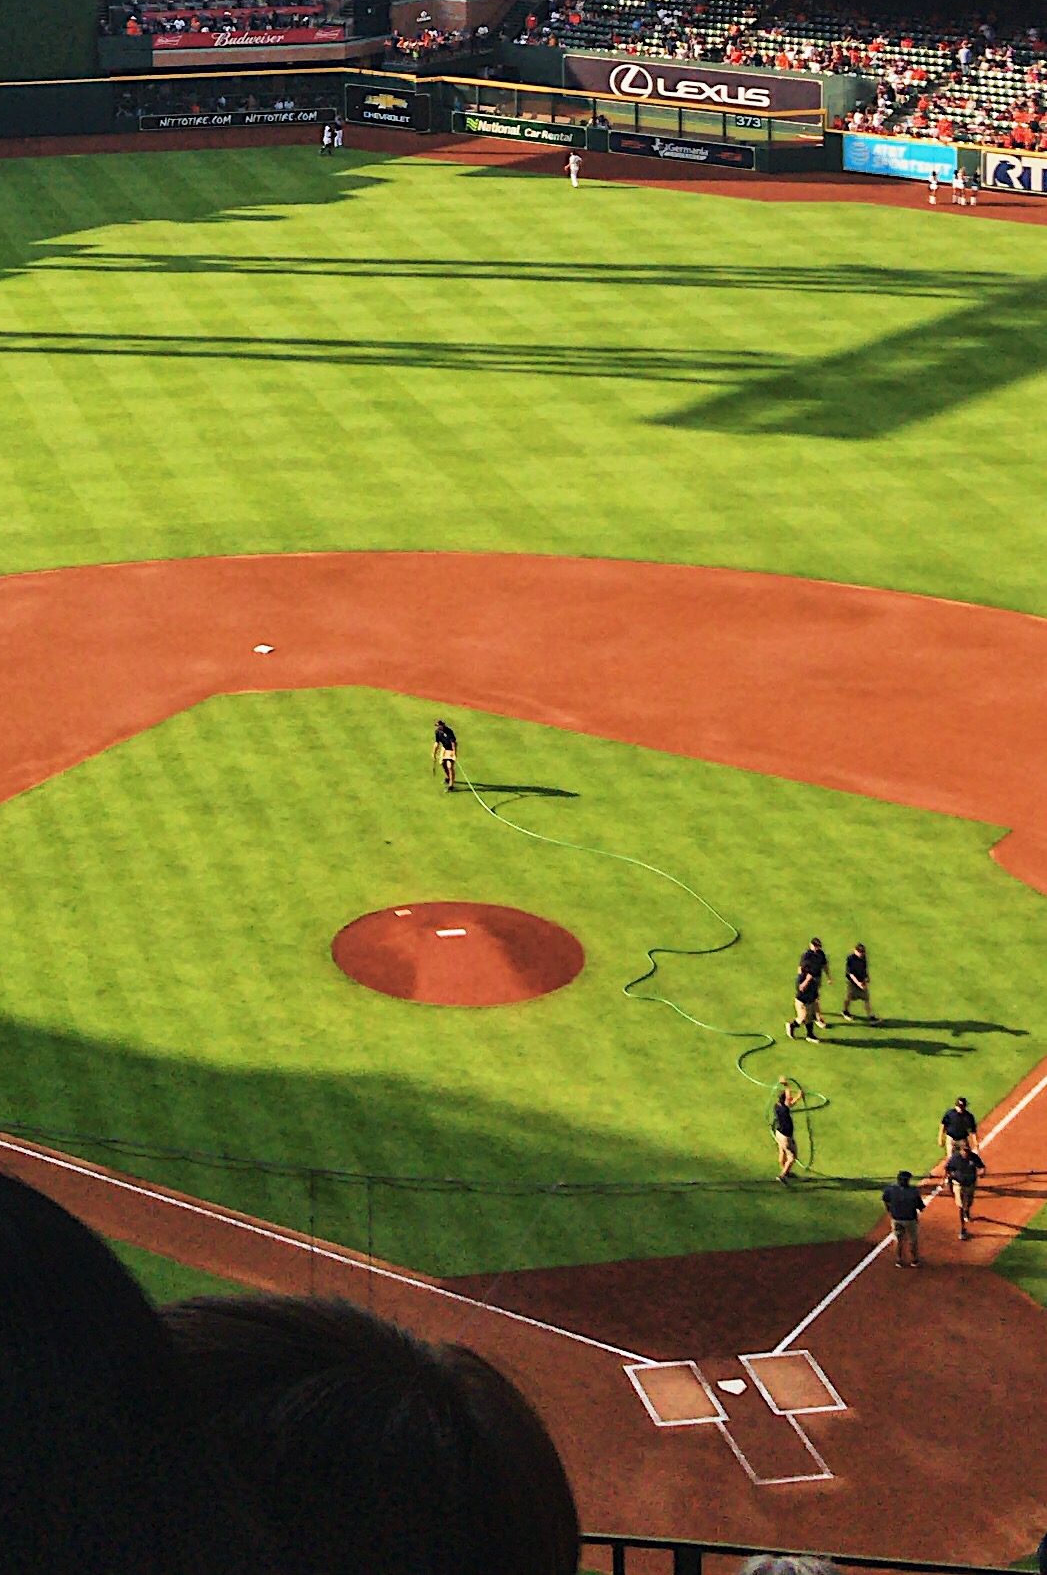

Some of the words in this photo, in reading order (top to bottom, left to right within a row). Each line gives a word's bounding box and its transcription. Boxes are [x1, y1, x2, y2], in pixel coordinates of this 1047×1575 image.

[211, 30, 285, 47] Budweiser
[656, 77, 771, 108] LEXUS
[159, 114, 232, 128] NITTOTIRE.COM
[245, 111, 318, 125] NITTOTIRE.COM
[363, 111, 410, 123] CHEVROLET
[736, 116, 761, 127] 373
[477, 119, 521, 136] National
[524, 127, 540, 139] Car
[541, 130, 574, 143] Rental
